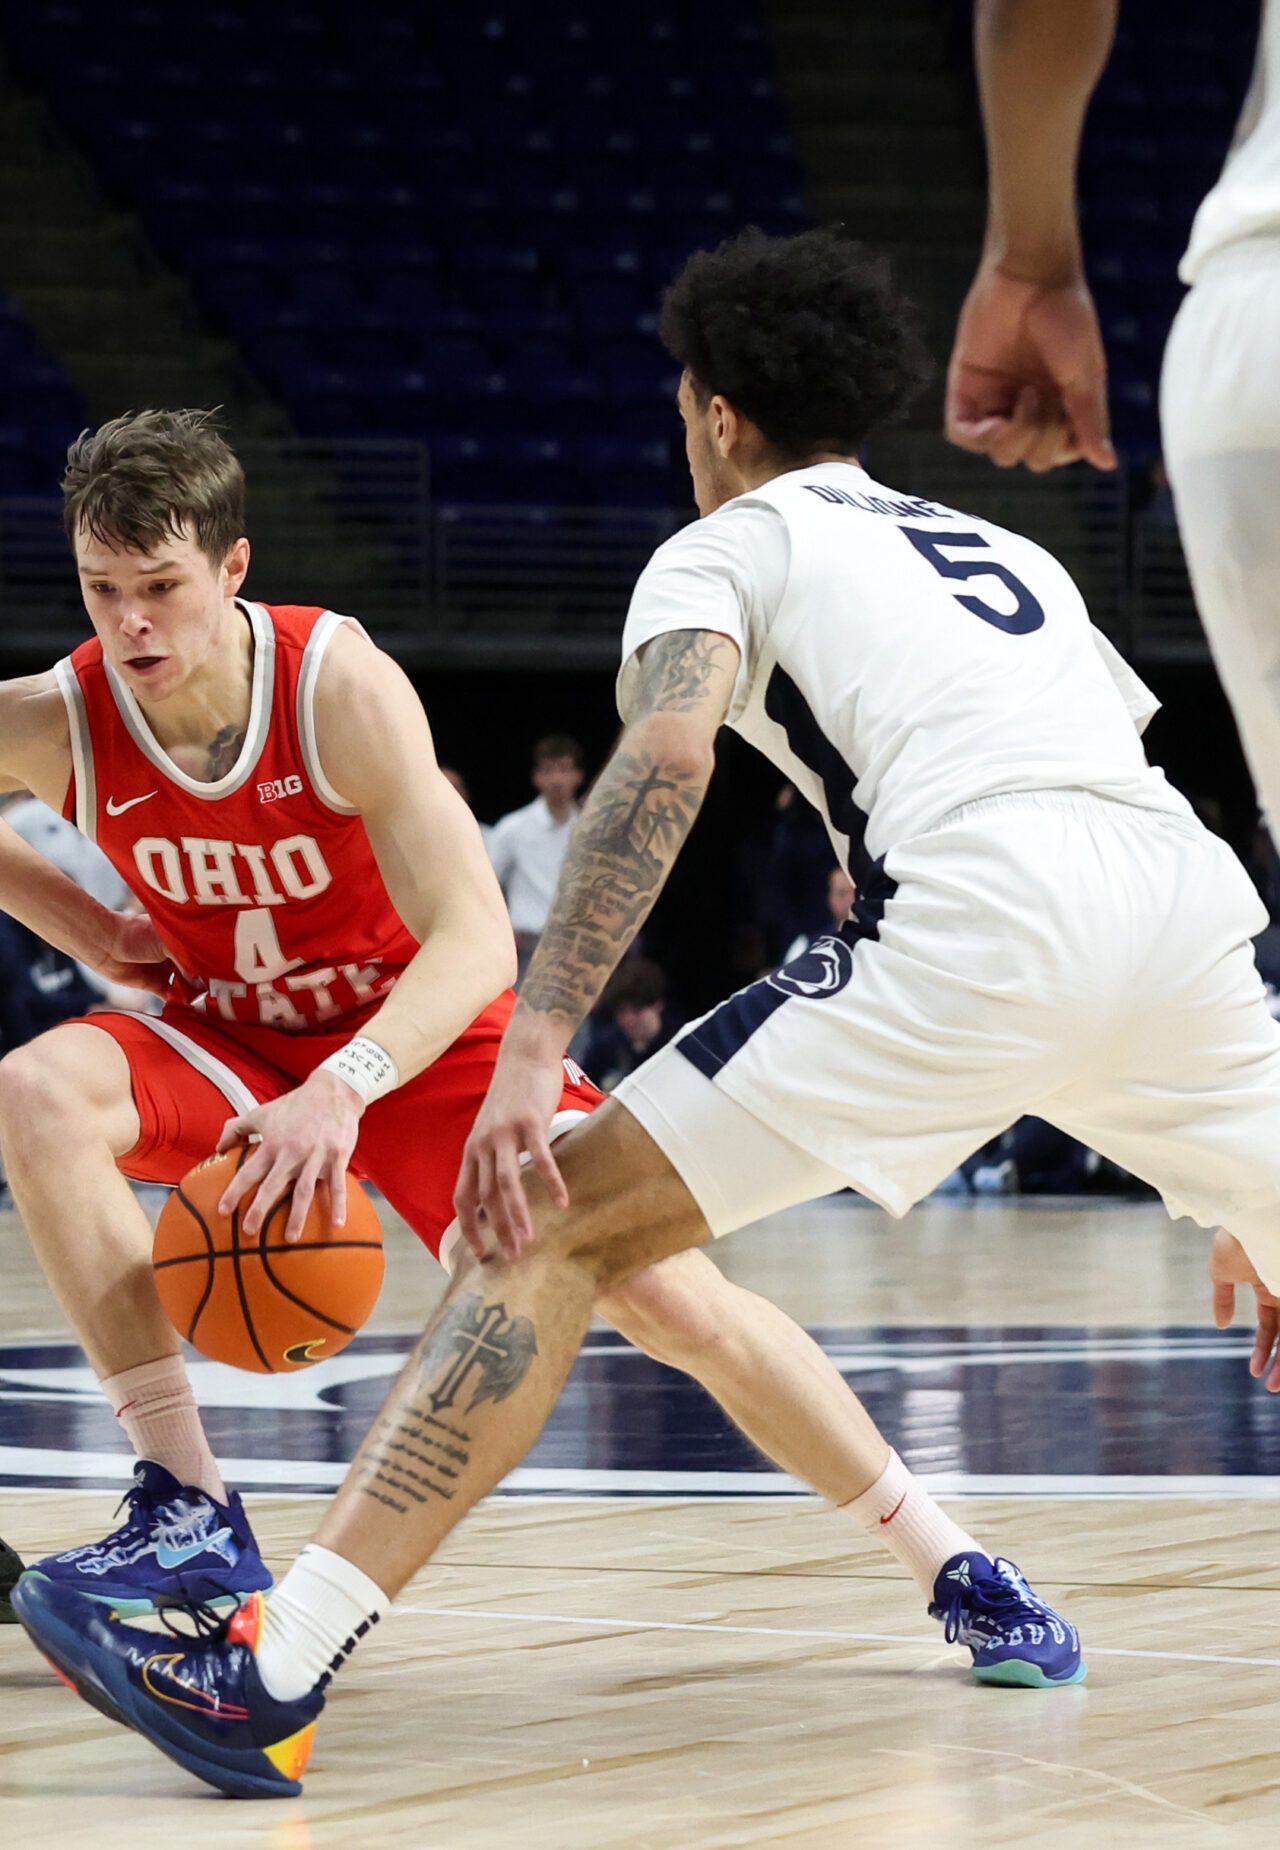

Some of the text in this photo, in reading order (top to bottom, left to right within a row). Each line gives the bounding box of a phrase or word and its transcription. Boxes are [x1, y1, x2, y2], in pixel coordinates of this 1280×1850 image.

[896, 525, 1045, 635] 5
[257, 774, 303, 804] BIG
[132, 834, 333, 905] OHIO
[233, 907, 306, 984] 4
[191, 956, 397, 1031] TATE
